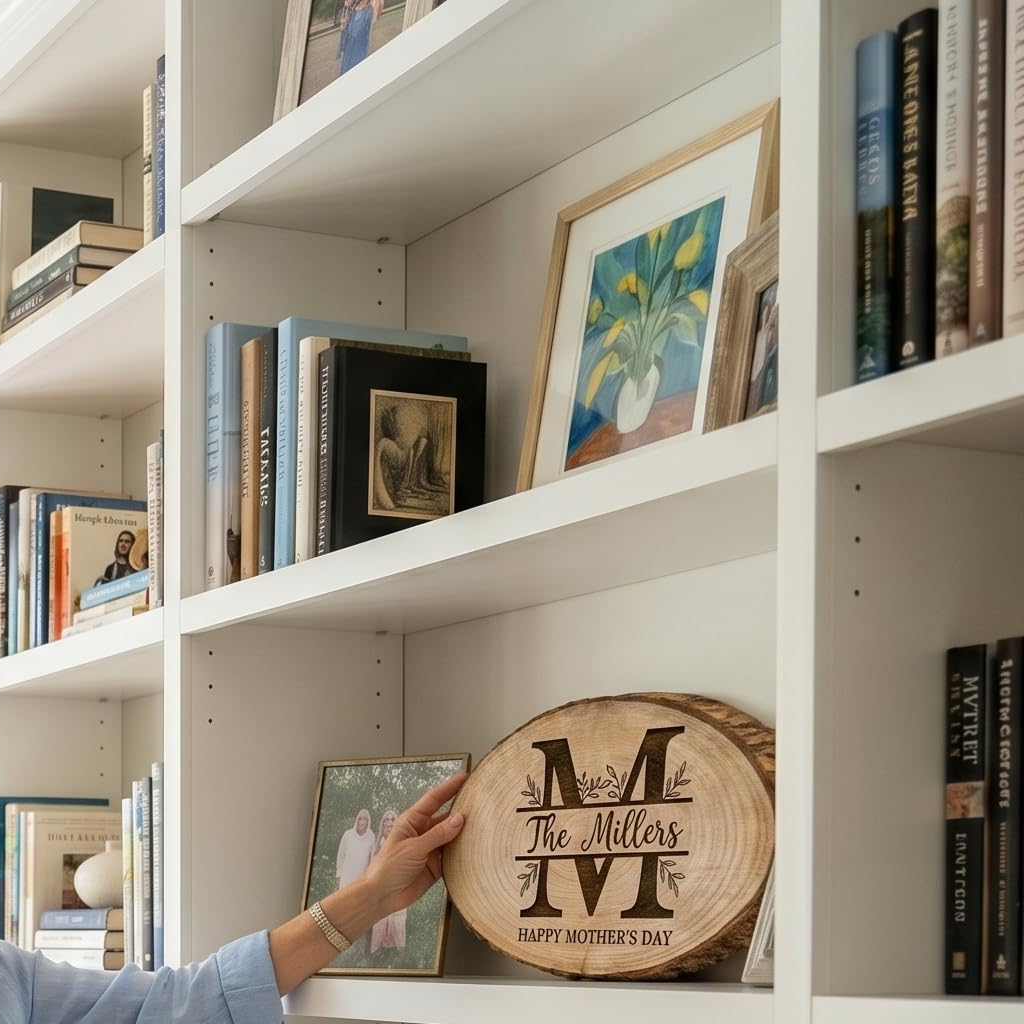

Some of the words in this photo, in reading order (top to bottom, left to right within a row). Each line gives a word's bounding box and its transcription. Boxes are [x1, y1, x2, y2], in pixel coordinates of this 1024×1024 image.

[520, 726, 685, 918] M
[526, 813, 572, 854] The
[581, 808, 684, 852] Millers
[518, 928, 563, 943] HAPPY
[565, 929, 638, 946] MOTHER'S
[641, 930, 673, 946] DAY
